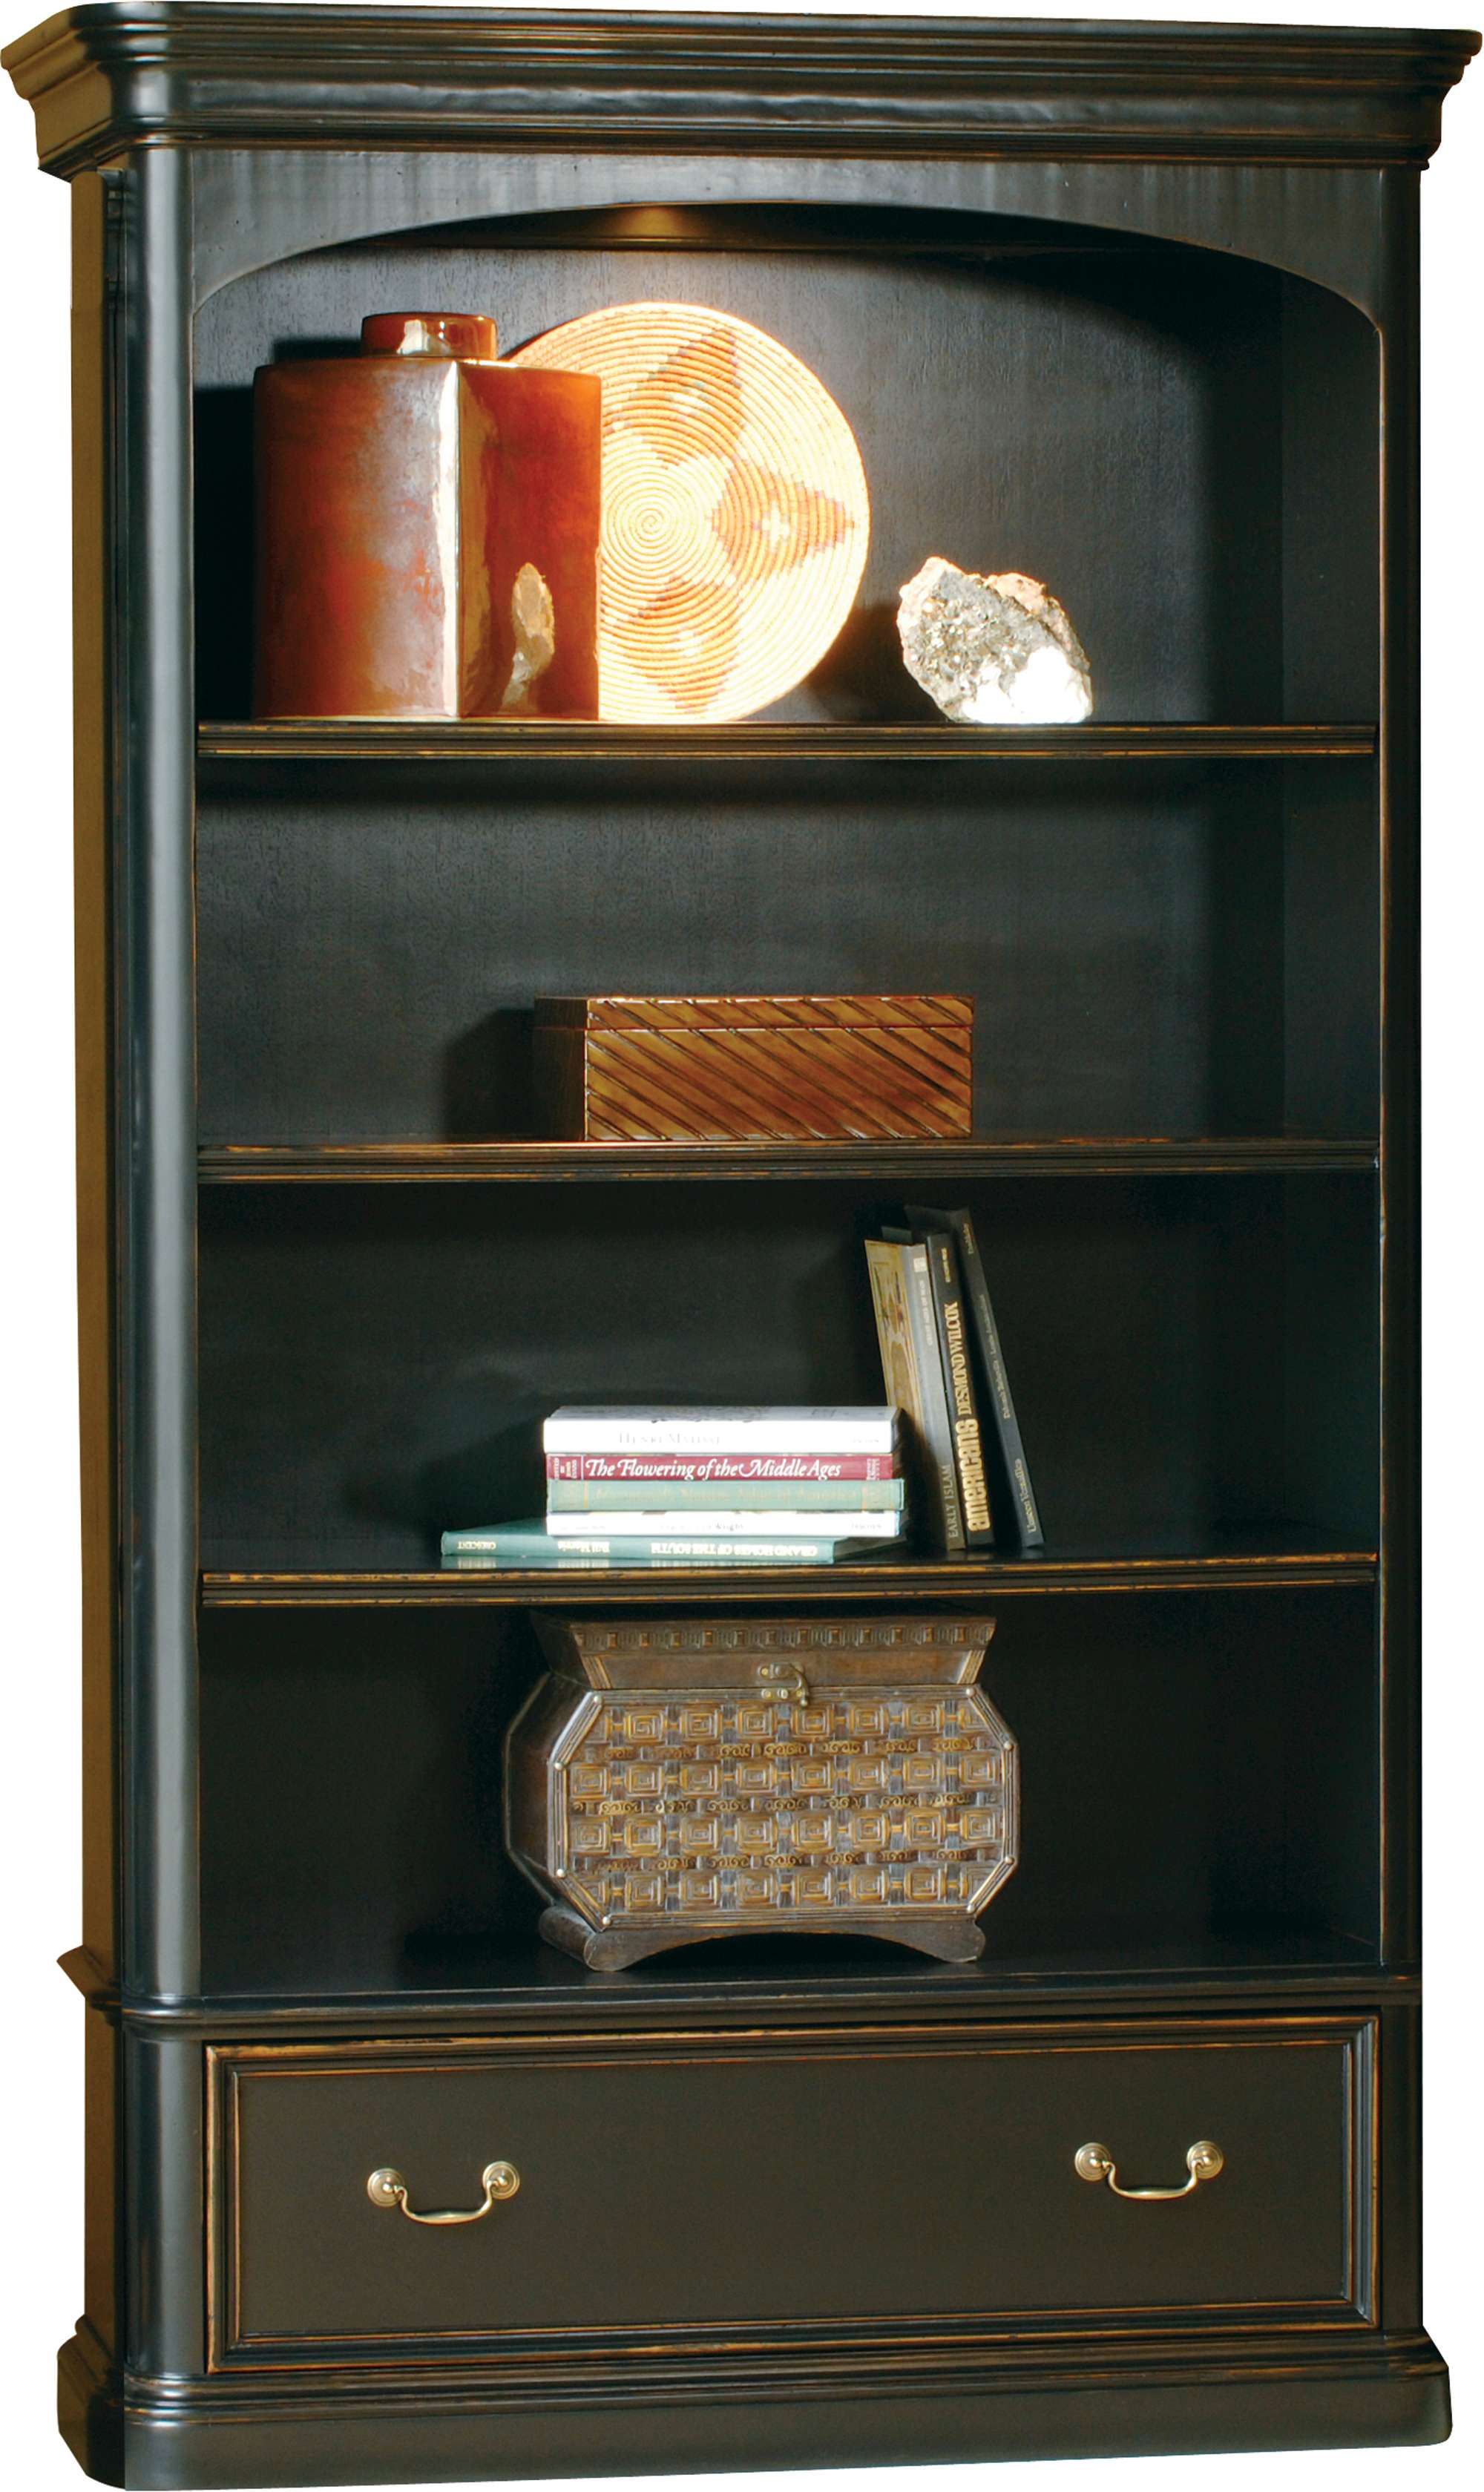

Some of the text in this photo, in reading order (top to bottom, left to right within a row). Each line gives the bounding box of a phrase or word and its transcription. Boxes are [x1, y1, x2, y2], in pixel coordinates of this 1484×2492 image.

[944, 1301, 963, 1354] WILCOX
[951, 1354, 972, 1416] DESMOND
[585, 1458, 615, 1477] The
[617, 1458, 696, 1481] Flowering
[697, 1458, 718, 1481] of
[715, 1458, 737, 1476] the
[738, 1458, 809, 1478] Middle
[806, 1460, 841, 1481] Ages
[942, 1464, 959, 1538] EARLY ISLAM
[651, 1542, 692, 1555] SOUTH
[692, 1543, 717, 1555] THE
[717, 1544, 733, 1555] OF
[774, 1545, 818, 1557] GRAND
